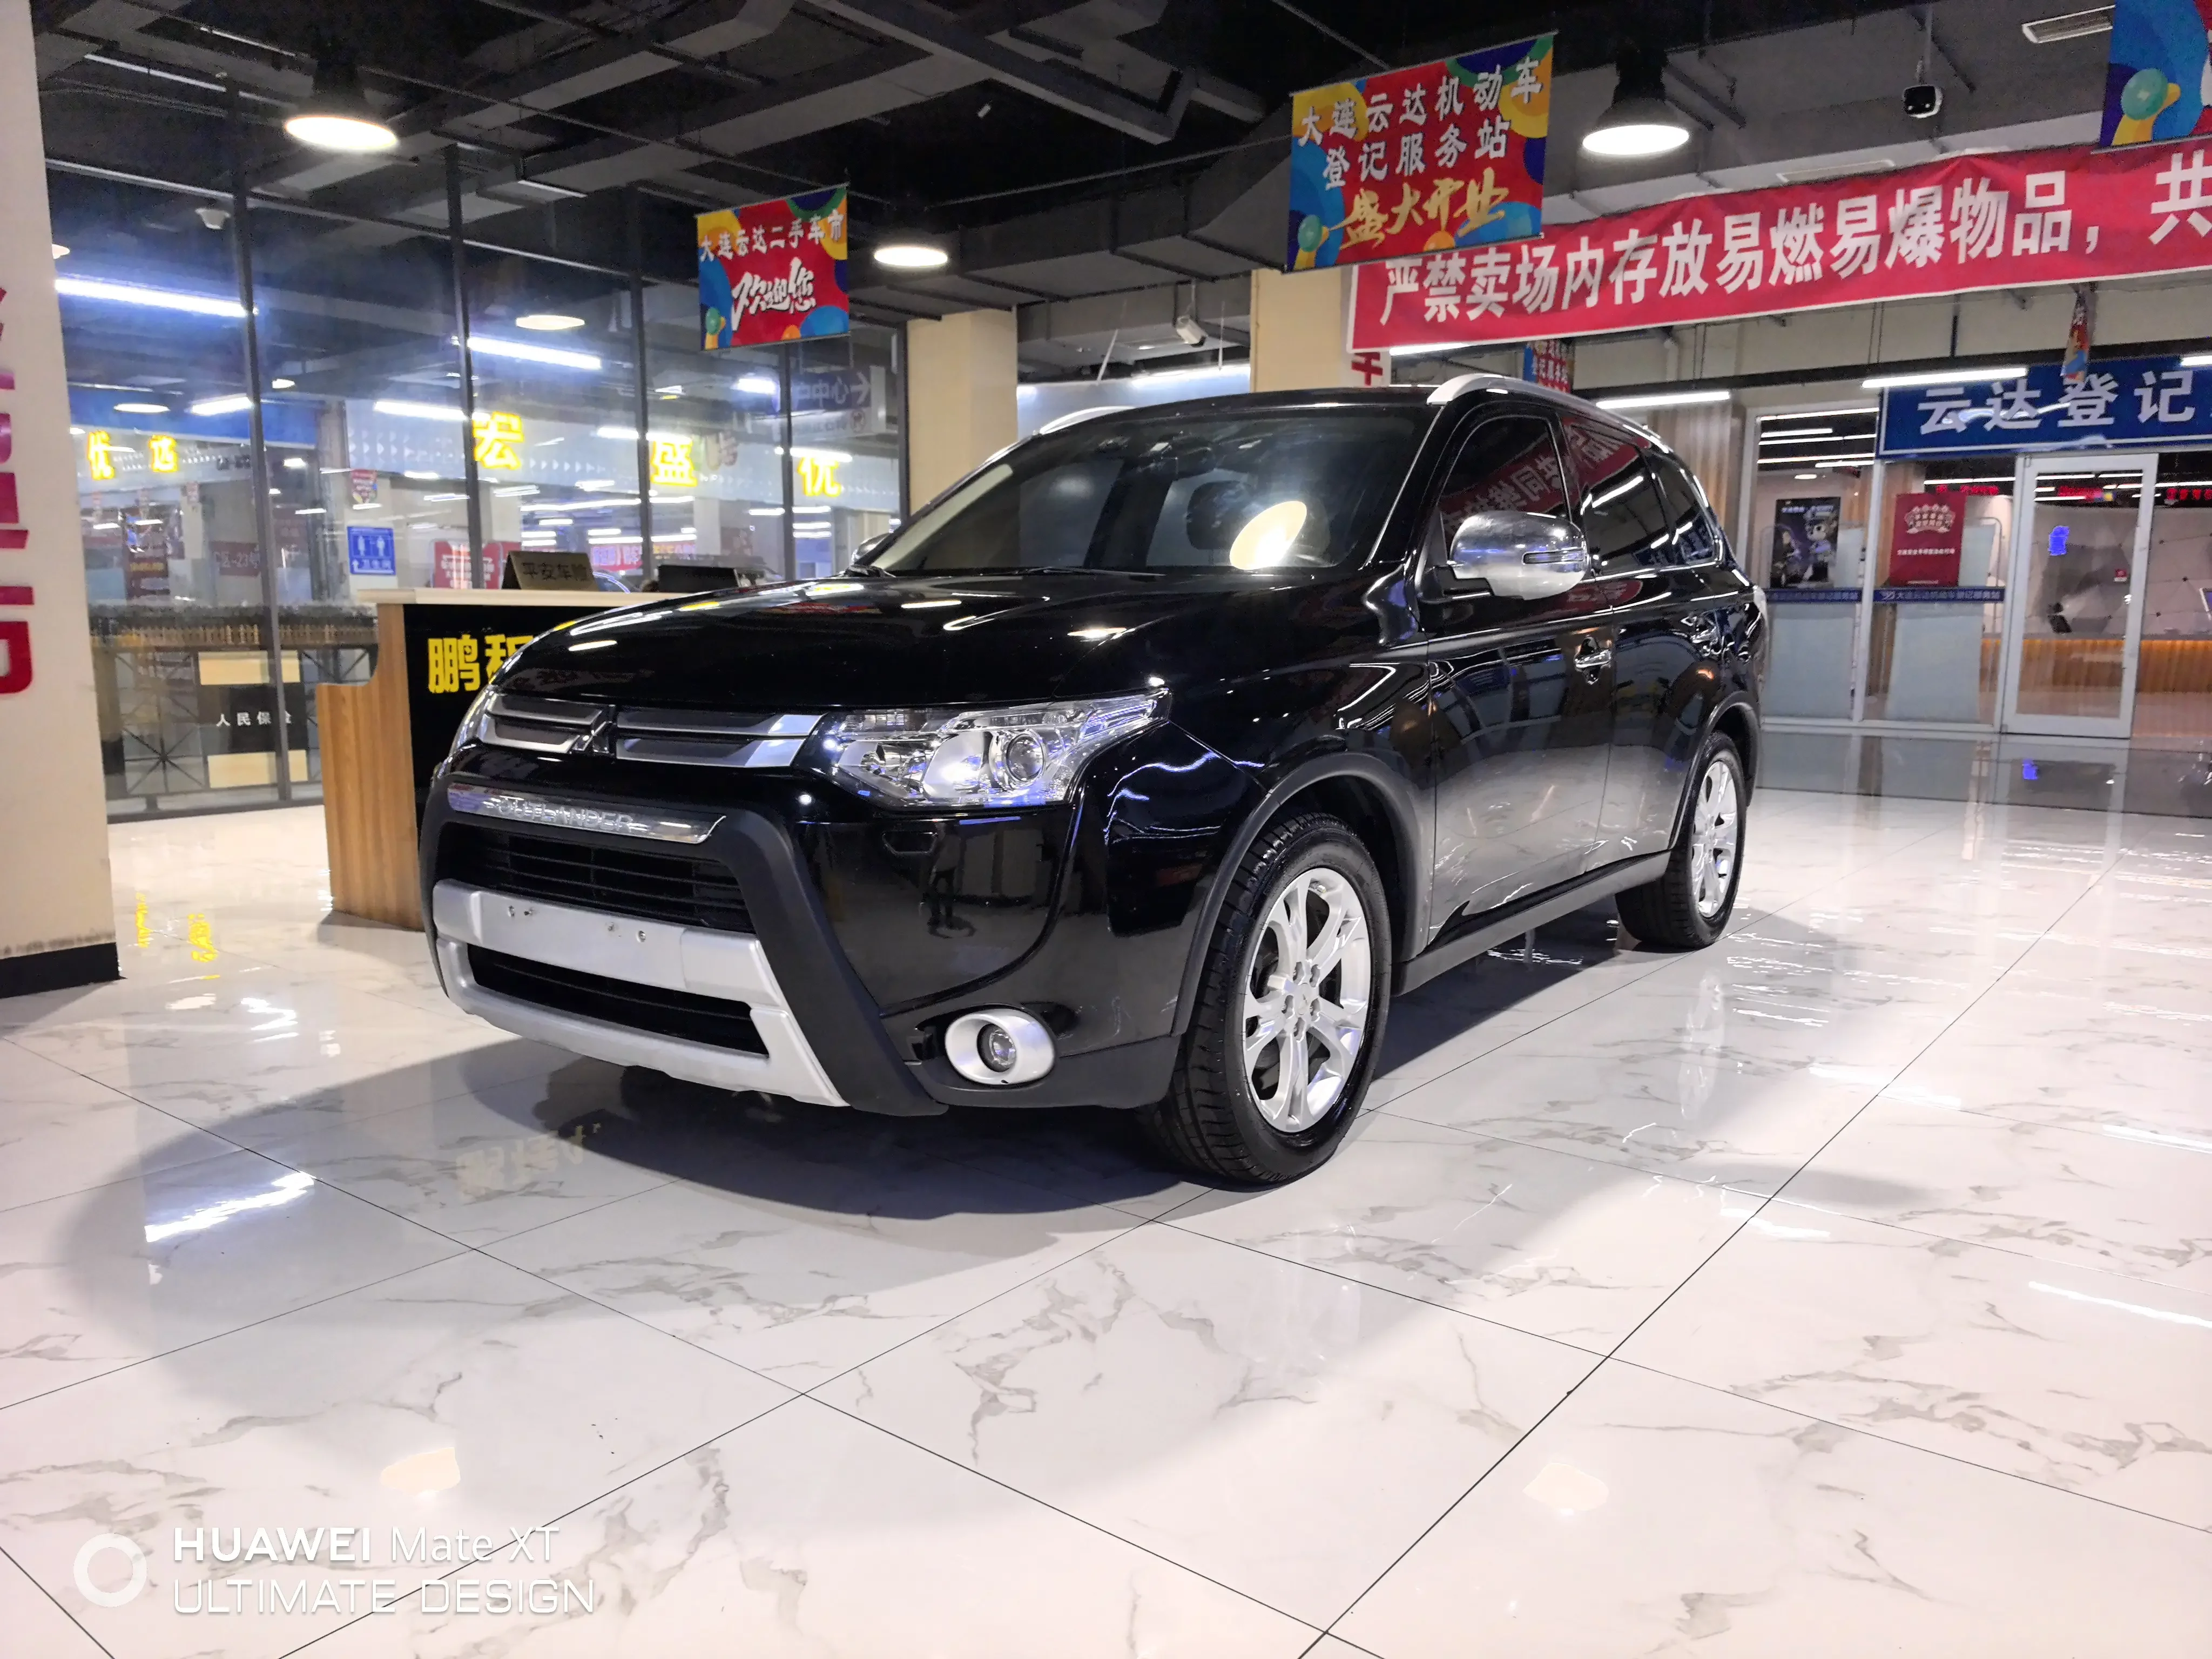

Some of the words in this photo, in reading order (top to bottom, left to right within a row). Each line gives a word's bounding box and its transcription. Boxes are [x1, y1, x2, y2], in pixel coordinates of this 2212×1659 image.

[1298, 56, 1544, 146] 大连云达机动车
[1323, 114, 1511, 191] 登记服务站
[1328, 167, 1509, 249] 盛大开业
[731, 257, 817, 331] 欢迎您
[1917, 371, 2196, 434] 云达登记
